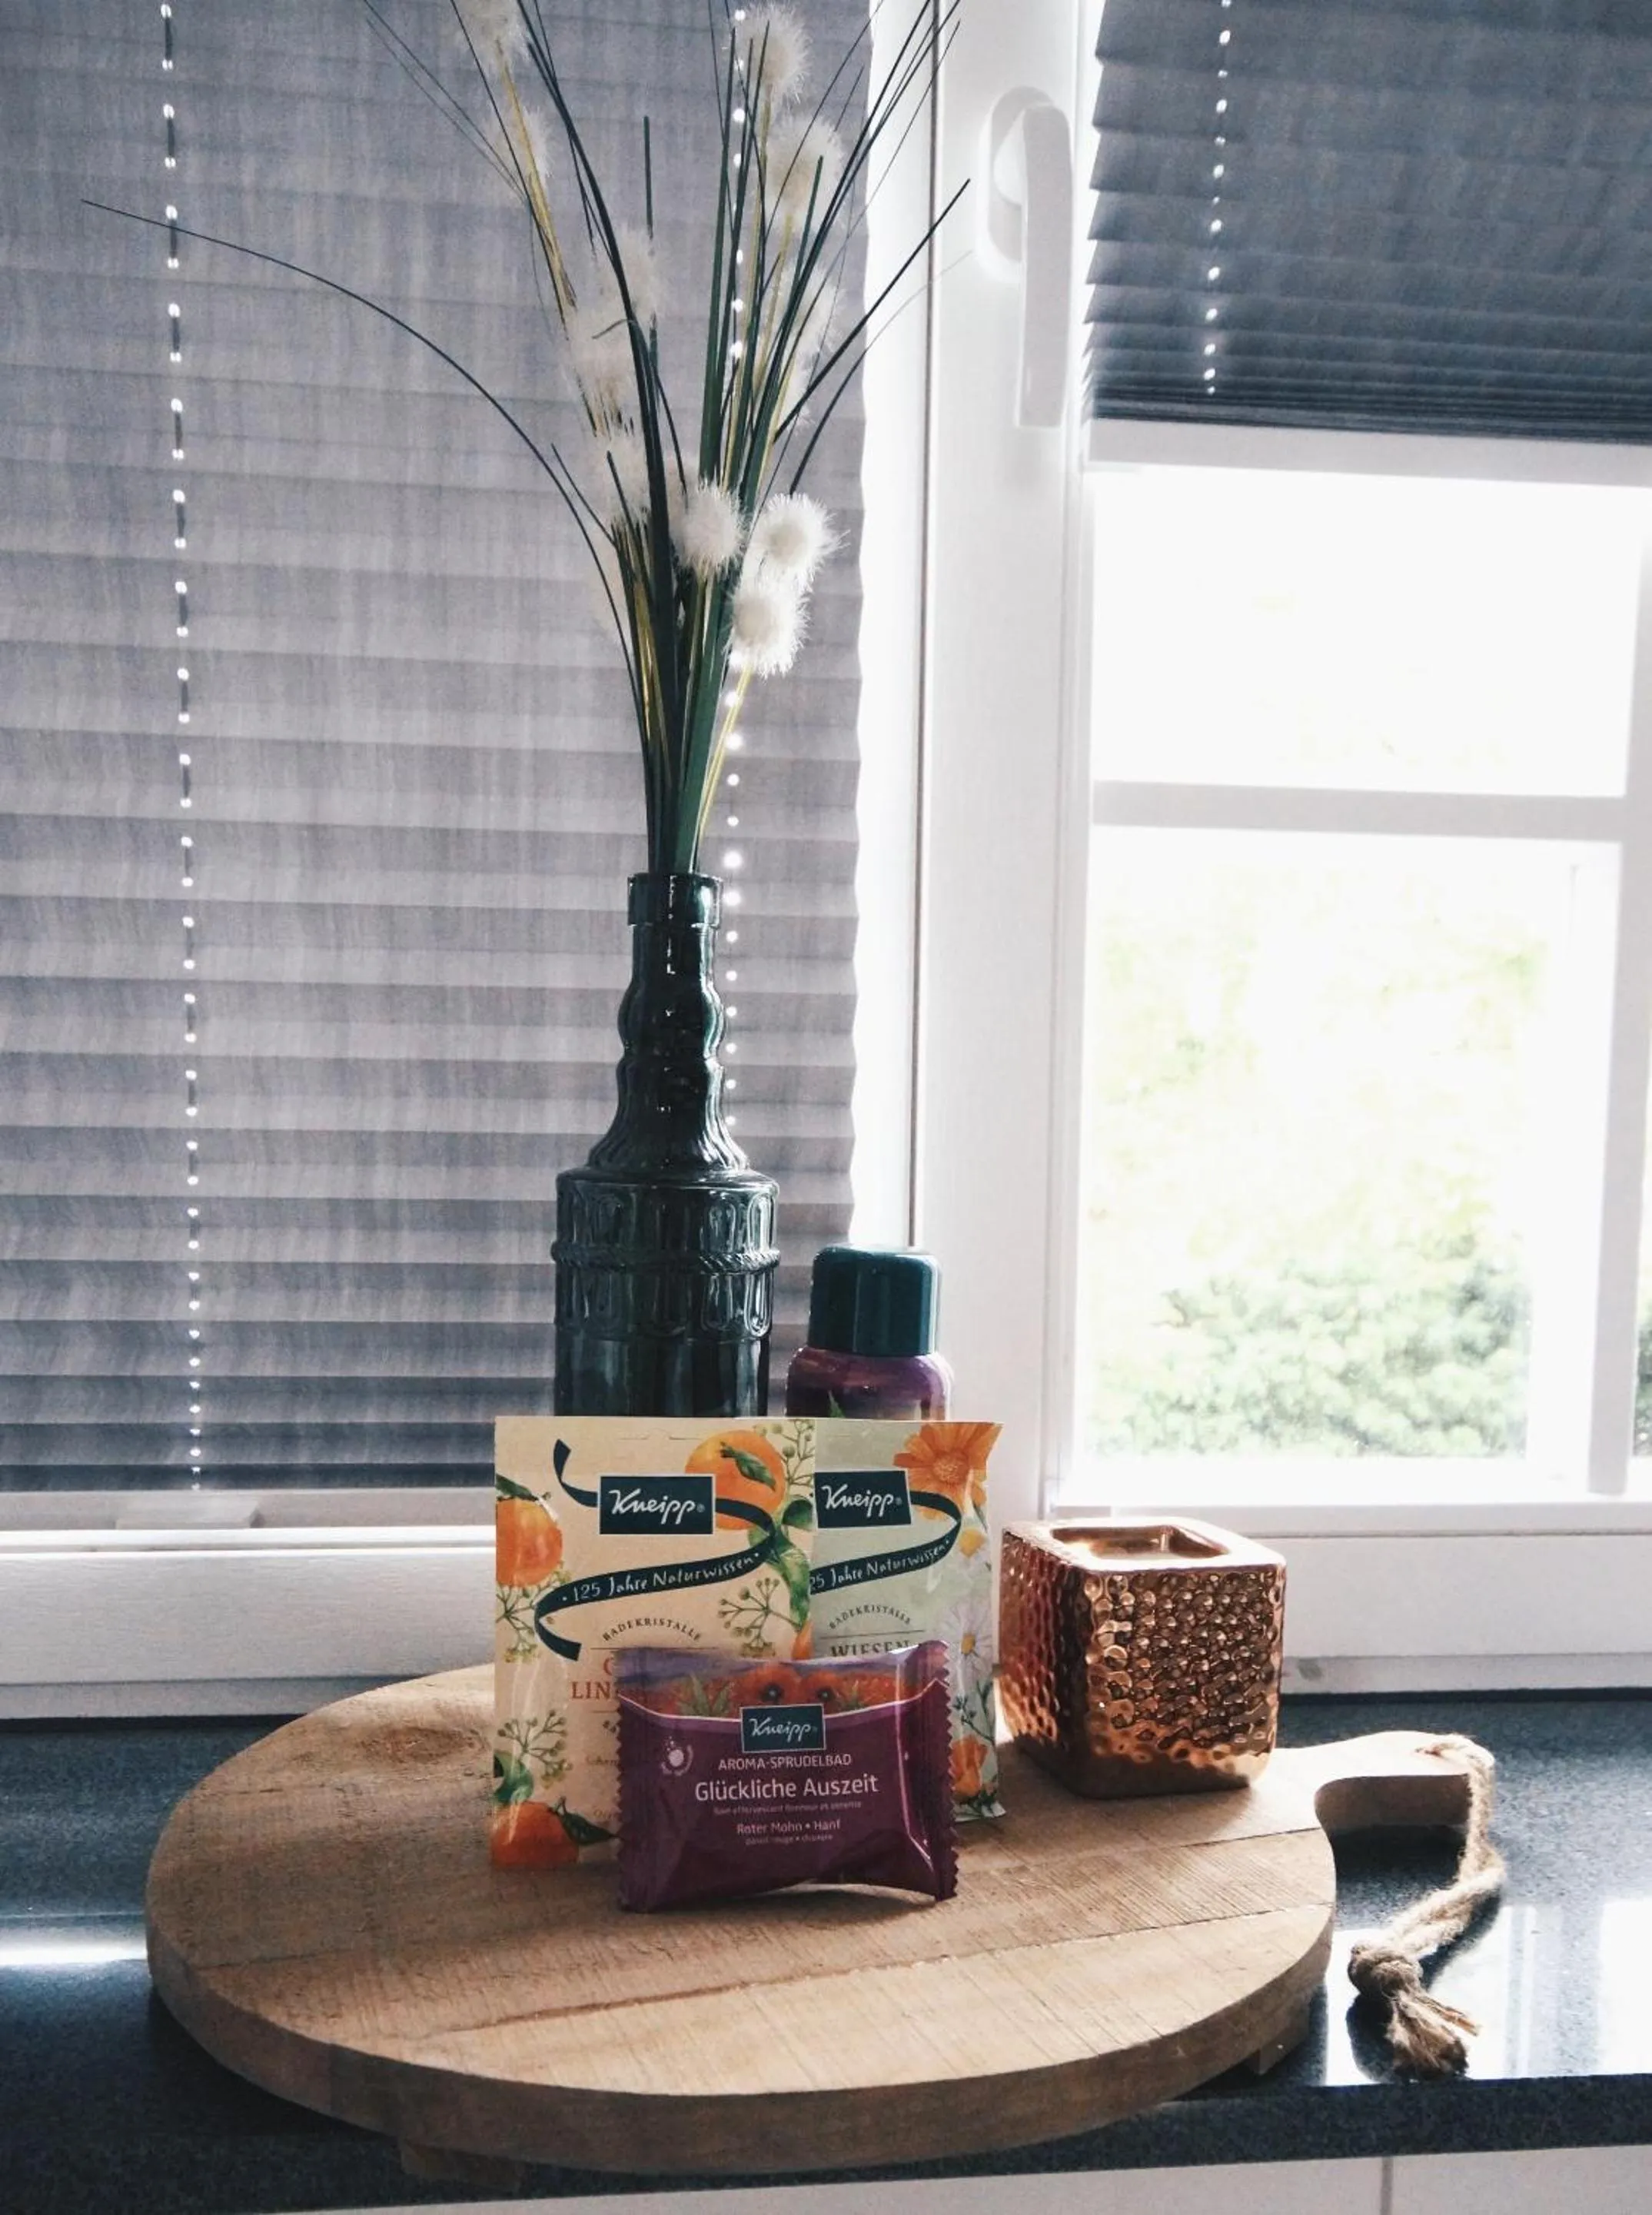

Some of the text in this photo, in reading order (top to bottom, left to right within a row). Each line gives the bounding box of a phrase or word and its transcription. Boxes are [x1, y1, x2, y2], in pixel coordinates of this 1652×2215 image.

[609, 1488, 696, 1525] Kneipp
[821, 1484, 894, 1517] Kneipp
[573, 1557, 753, 1601] 125 Jahre Naturwissen
[809, 1546, 946, 1591] 25 Jahre Naturwissen
[602, 1618, 701, 1641] BADEKRISTALLE
[570, 1681, 614, 1700] LIN
[749, 1716, 812, 1743] Kneipp
[718, 1754, 852, 1771] AROMA-SPRUDELBAD
[695, 1772, 879, 1801] Glückliche Auszeit
[771, 1821, 803, 1833] Mohn
[813, 1818, 841, 1831] Hanf
